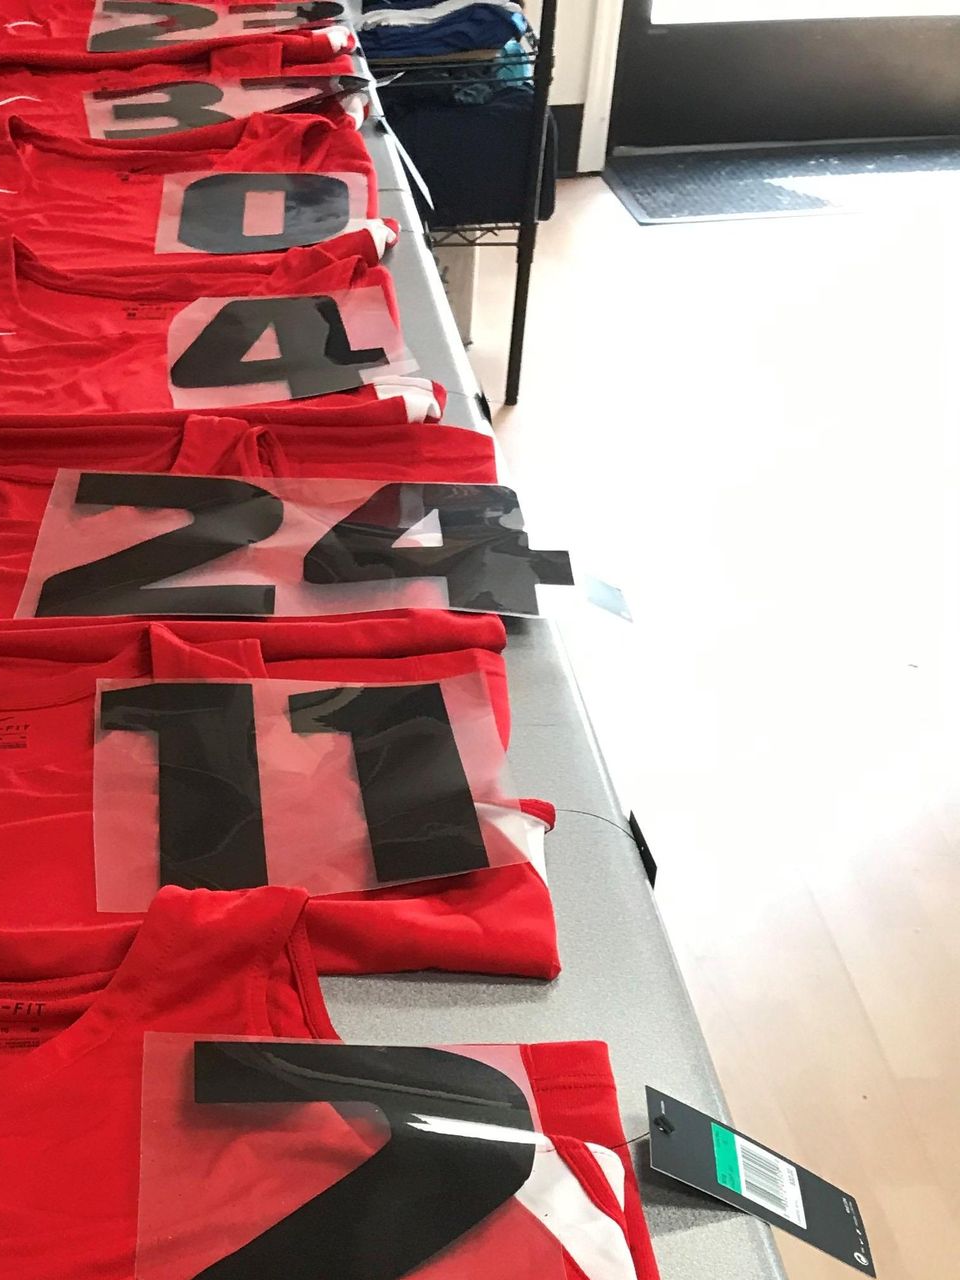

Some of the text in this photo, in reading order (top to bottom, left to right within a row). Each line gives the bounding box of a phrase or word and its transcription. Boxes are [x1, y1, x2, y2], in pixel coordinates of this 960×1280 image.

[177, 173, 349, 254] 0
[170, 296, 390, 400] 4
[35, 472, 575, 618] 24
[101, 683, 490, 888] 11
